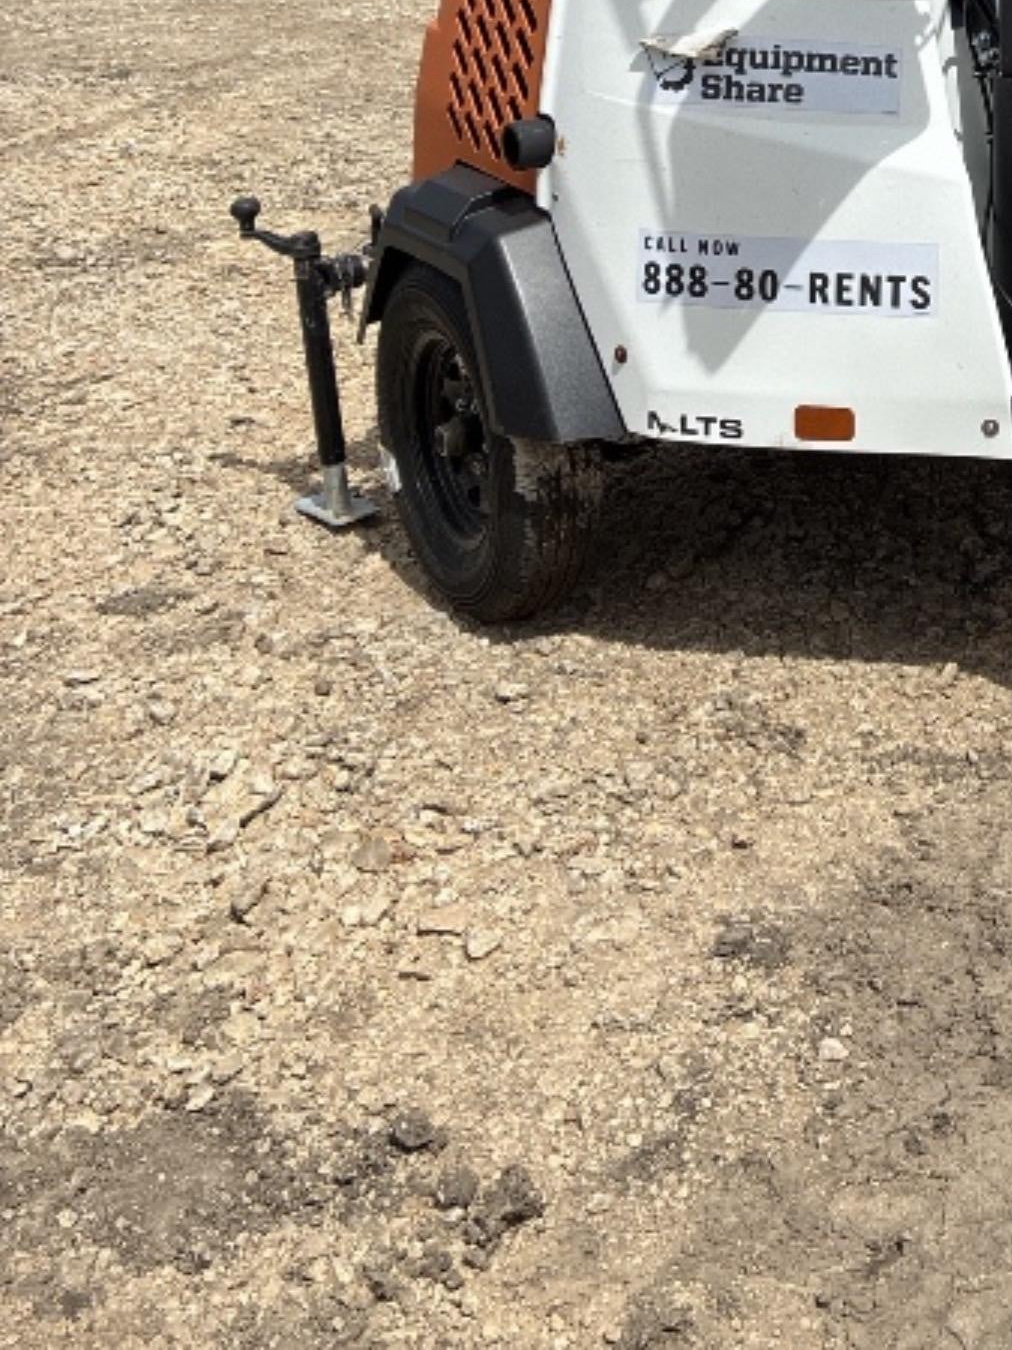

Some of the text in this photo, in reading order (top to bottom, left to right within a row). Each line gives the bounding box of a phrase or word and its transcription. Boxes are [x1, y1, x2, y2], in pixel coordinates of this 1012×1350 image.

[701, 74, 805, 103] Share
[644, 236, 741, 256] CALL NOW
[643, 260, 932, 310] 888-80-RENTS
